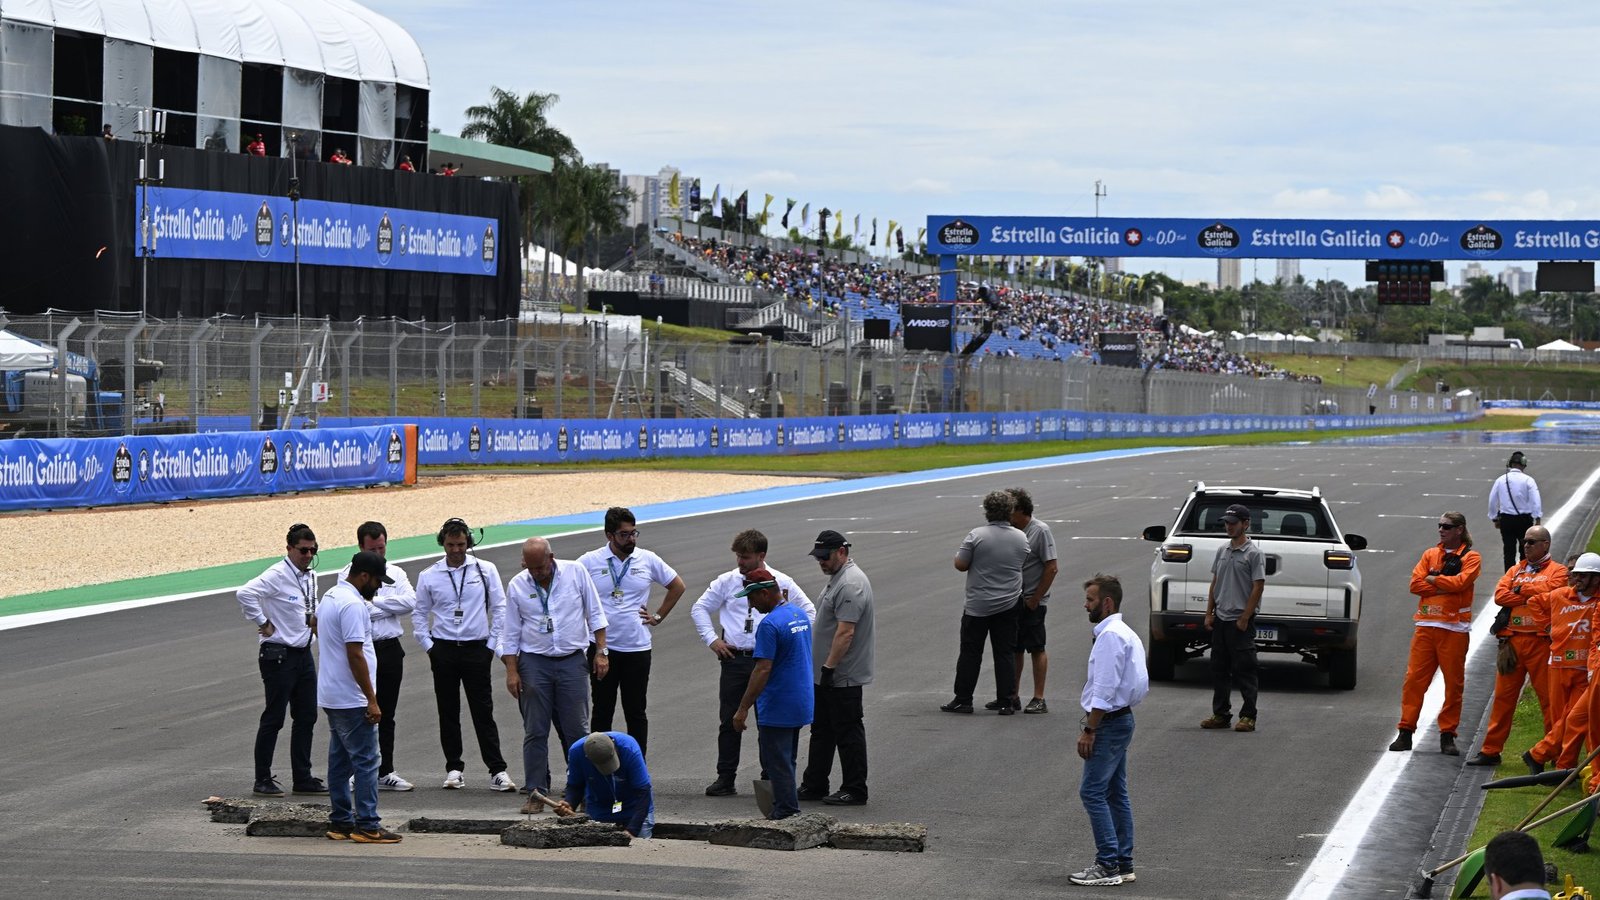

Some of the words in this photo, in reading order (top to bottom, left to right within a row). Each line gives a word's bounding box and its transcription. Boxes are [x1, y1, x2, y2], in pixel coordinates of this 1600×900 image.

[153, 205, 190, 240] Estrella
[192, 207, 225, 241] Galicia
[257, 216, 272, 229] Estrella
[257, 229, 271, 242] Galicia
[324, 217, 352, 248] Galicia
[944, 228, 973, 236] Estrella
[945, 235, 972, 244] Galicia
[990, 226, 1056, 244] Estrella
[1060, 226, 1120, 245] Galicia
[1156, 230, 1176, 245] 0,0
[1204, 230, 1233, 240] Estrella
[1250, 228, 1316, 246] Estrella
[1320, 229, 1382, 247] Galicia
[1418, 232, 1439, 248] 0,0
[1466, 232, 1496, 240] Estrella
[1514, 230, 1580, 248] Estrella
[408, 226, 436, 255] Estrella
[436, 228, 460, 257] Galicia
[1205, 239, 1232, 247] Galicia
[1468, 240, 1495, 248] Galicia
[906, 319, 950, 328] MotoGP
[424, 428, 448, 452] Galicia
[494, 430, 517, 452] Estrella
[518, 429, 539, 451] Galicia
[580, 430, 602, 451] Estrella
[116, 457, 130, 468] Estrella
[295, 442, 330, 470] Estrella
[331, 440, 361, 468] Galicia
[36, 452, 76, 486] Galicia
[152, 449, 190, 480] Estrella
[192, 446, 228, 478] Galicia
[116, 468, 129, 479] Galicia
[790, 625, 808, 634] STAFF
